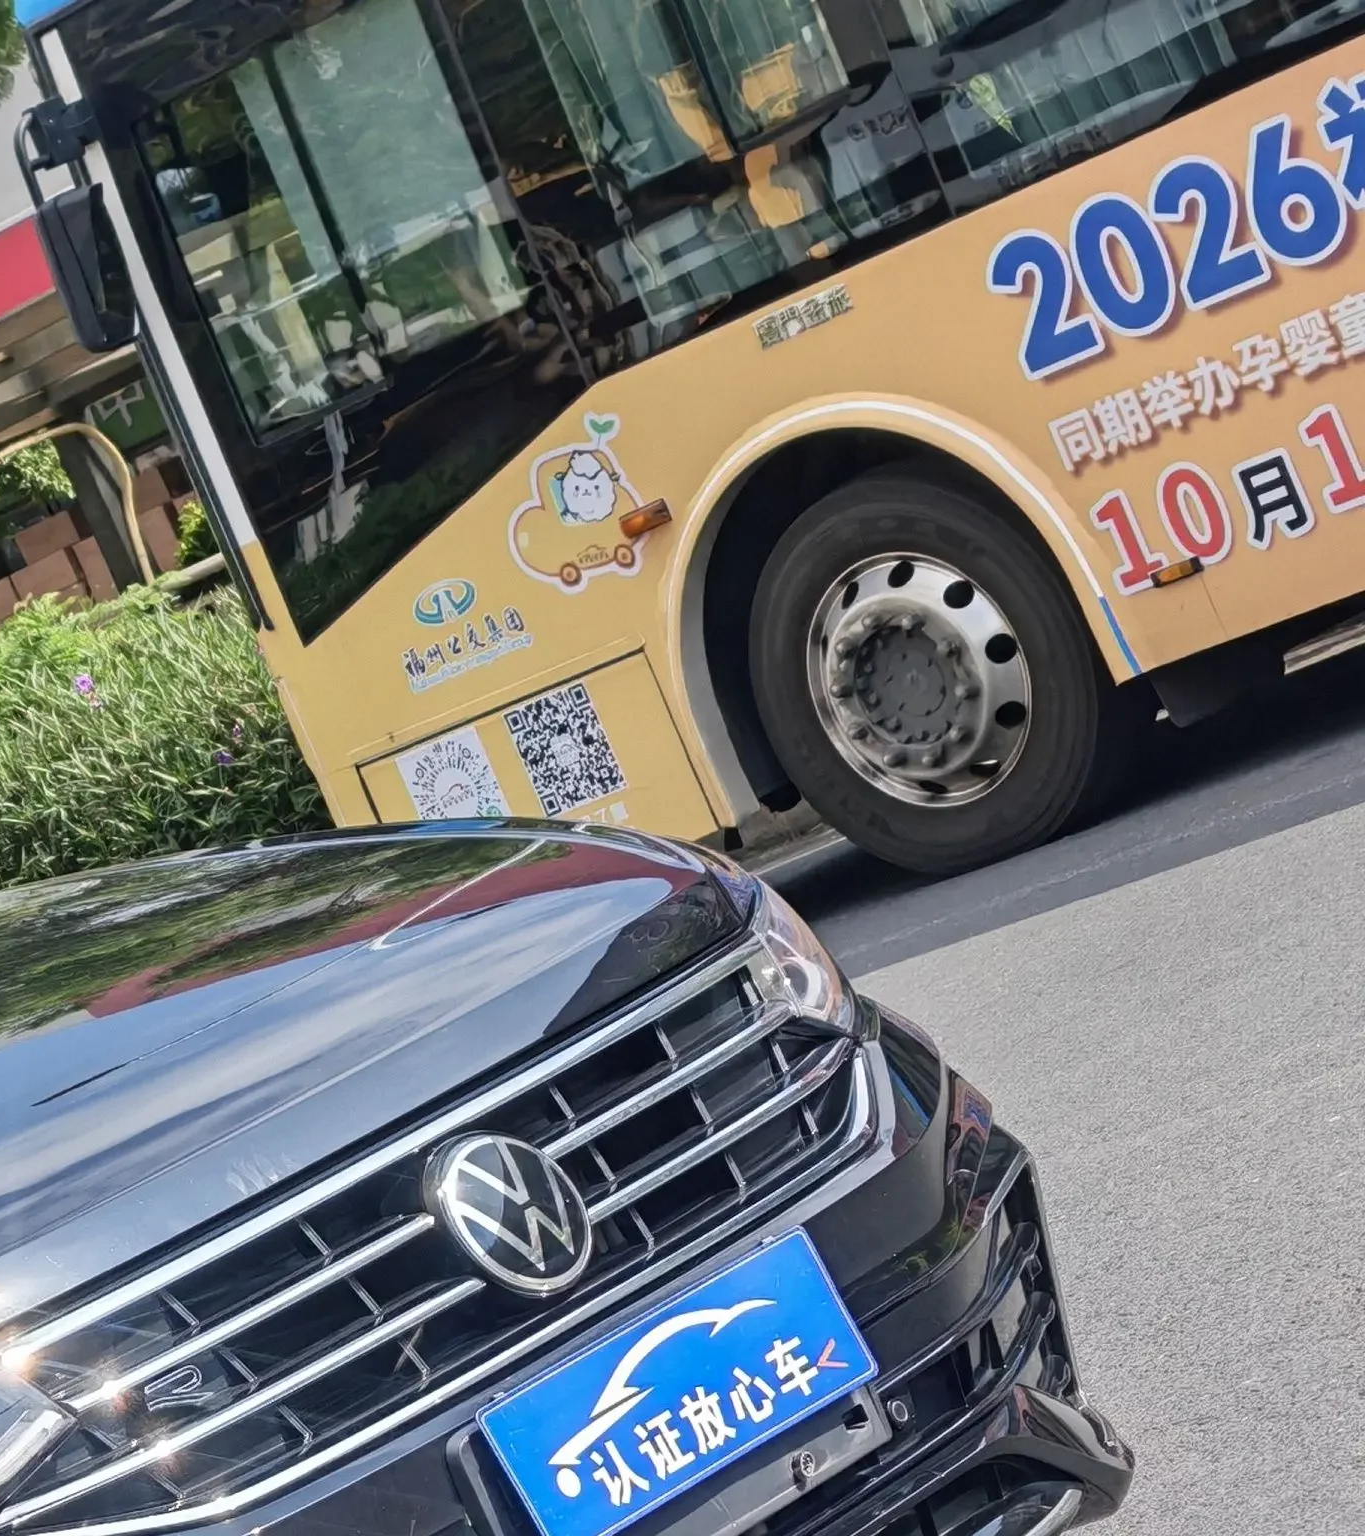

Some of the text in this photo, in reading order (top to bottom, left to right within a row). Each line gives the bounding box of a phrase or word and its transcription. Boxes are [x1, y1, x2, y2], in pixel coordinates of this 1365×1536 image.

[404, 607, 525, 677] 福州公交集团
[441, 1134, 590, 1290] VW
[593, 1336, 819, 1507] 认证放心车
